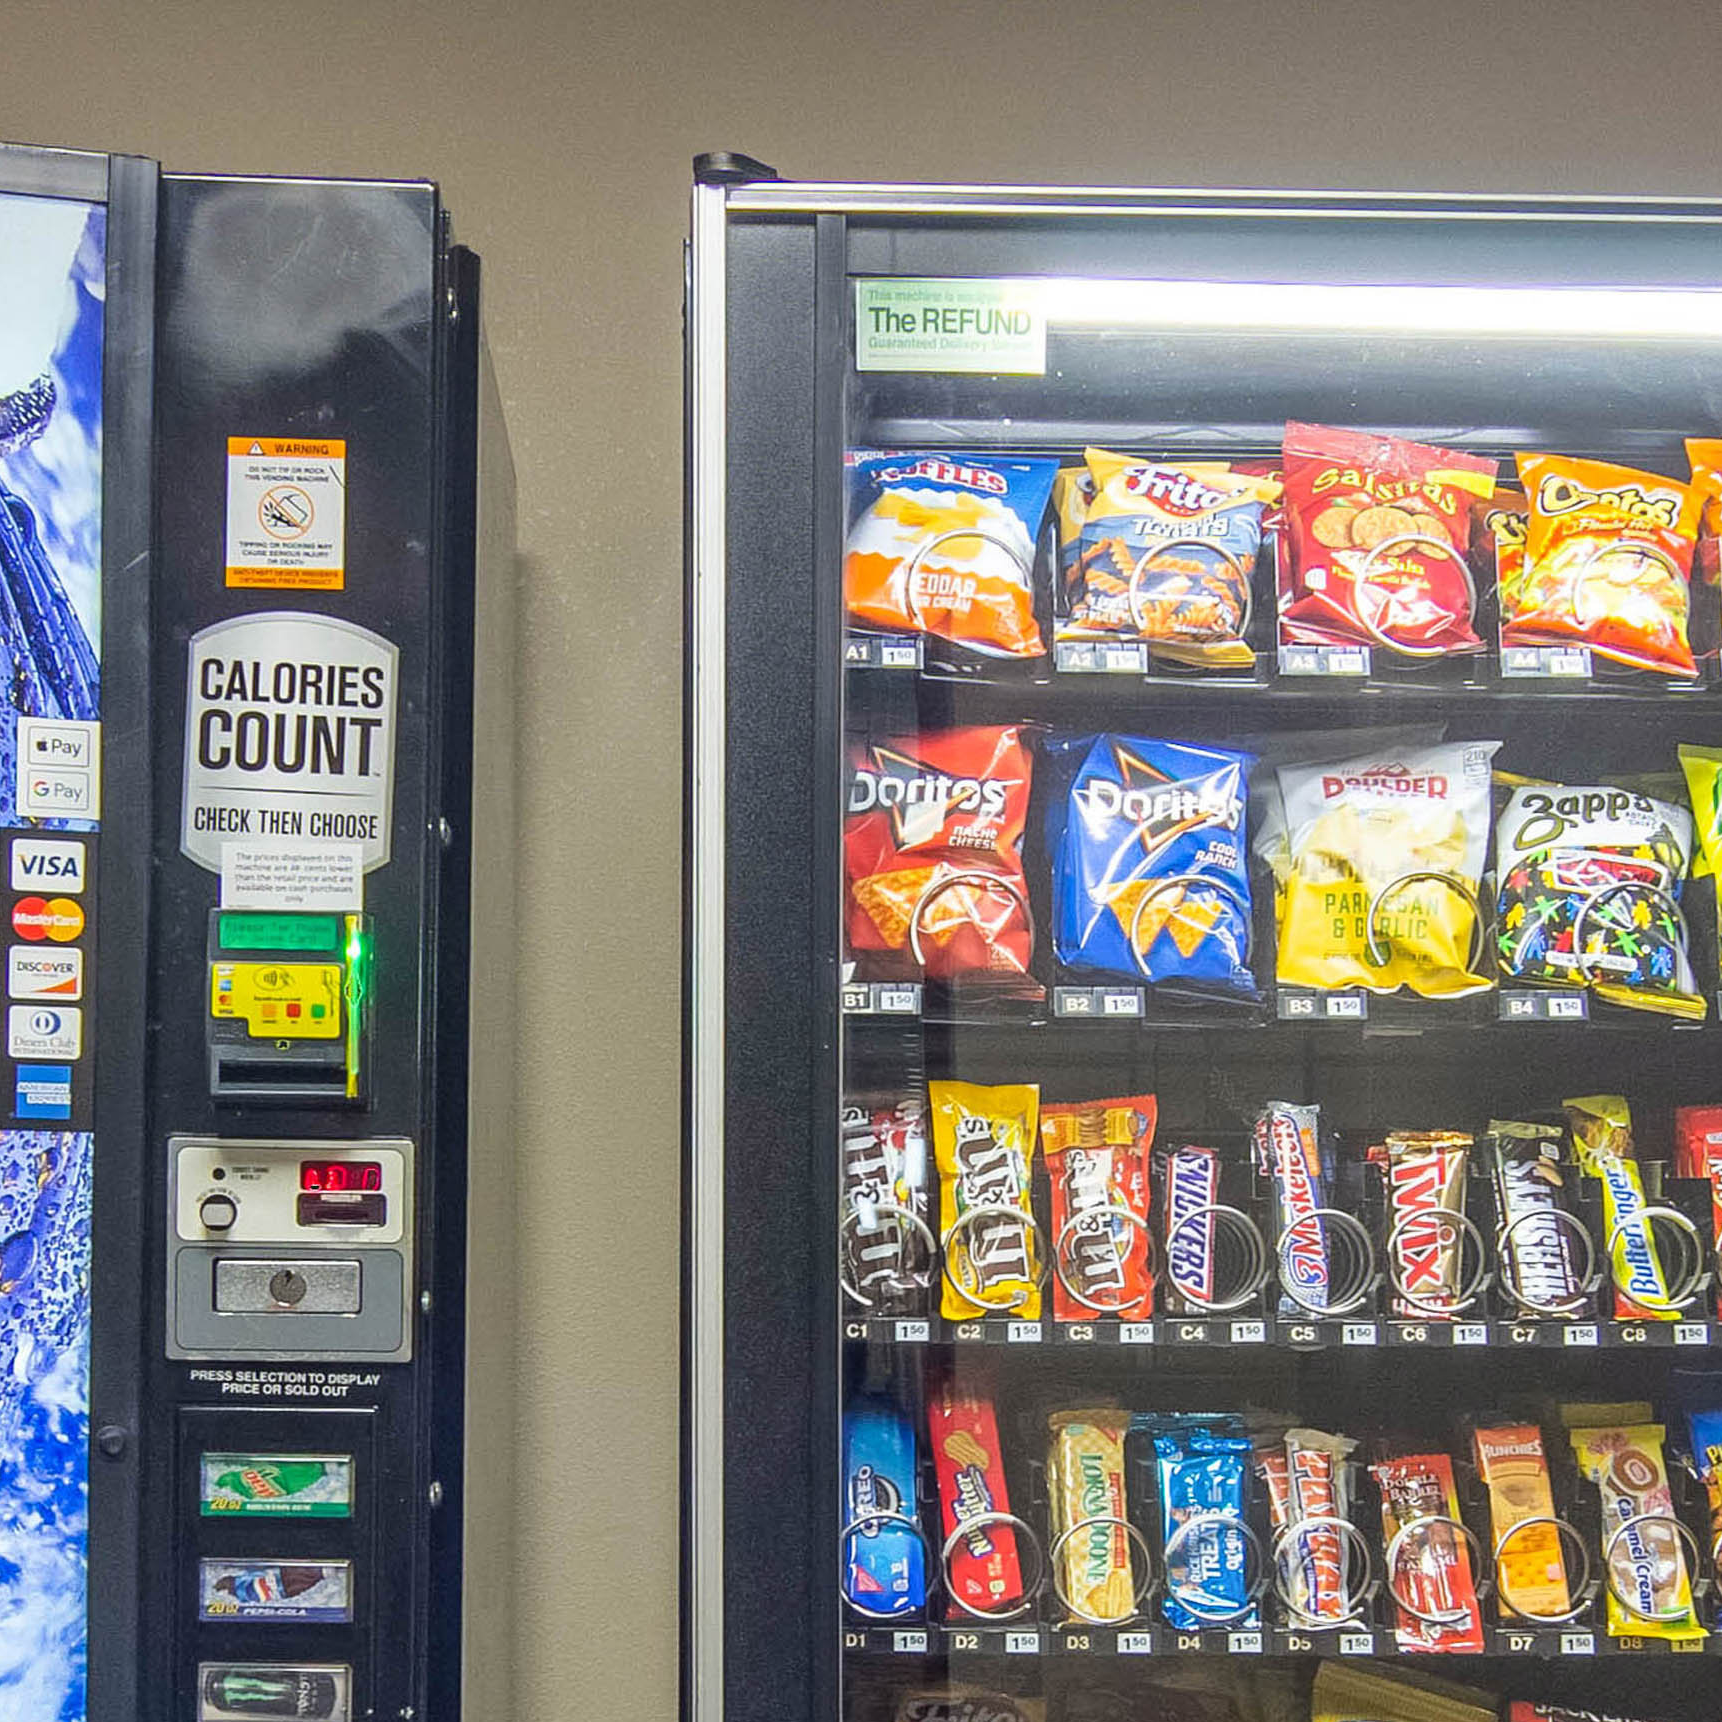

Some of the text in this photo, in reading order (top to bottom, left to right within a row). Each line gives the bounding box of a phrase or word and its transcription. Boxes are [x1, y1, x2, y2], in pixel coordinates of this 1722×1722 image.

[868, 307, 1031, 336] The REFUND
[274, 444, 329, 455] WARNING
[200, 658, 384, 709] CALORIES
[51, 738, 82, 758] Pay
[199, 708, 382, 777] COUNT
[54, 782, 83, 800] Pay
[849, 772, 1006, 812] Doritos
[1323, 776, 1448, 799] BOULDER
[1089, 779, 1243, 829] Doritos
[194, 806, 379, 839] CHECK THEN CHOOSE
[18, 854, 79, 877] VISA
[16, 961, 75, 973] DISCOVER
[845, 993, 866, 1008] B1
[1066, 998, 1090, 1012] B2
[1289, 1000, 1314, 1013] B3
[1510, 1001, 1534, 1015] B4
[1170, 1153, 1210, 1290] SNICKERS
[846, 1325, 868, 1338] C1
[957, 1325, 981, 1340] C2
[1069, 1326, 1093, 1340] C3
[1180, 1326, 1205, 1340] C4
[1402, 1327, 1426, 1341] C6
[1622, 1328, 1646, 1342] C8
[191, 1370, 380, 1386] PRESS SELECTION TO DISPLAY
[222, 1383, 349, 1397] PRICE OR SOLD OUT
[845, 1634, 867, 1648] D1
[1066, 1636, 1090, 1649] D3
[1178, 1637, 1201, 1650] D4
[1288, 1637, 1312, 1651] D5
[1510, 1638, 1533, 1651] D7
